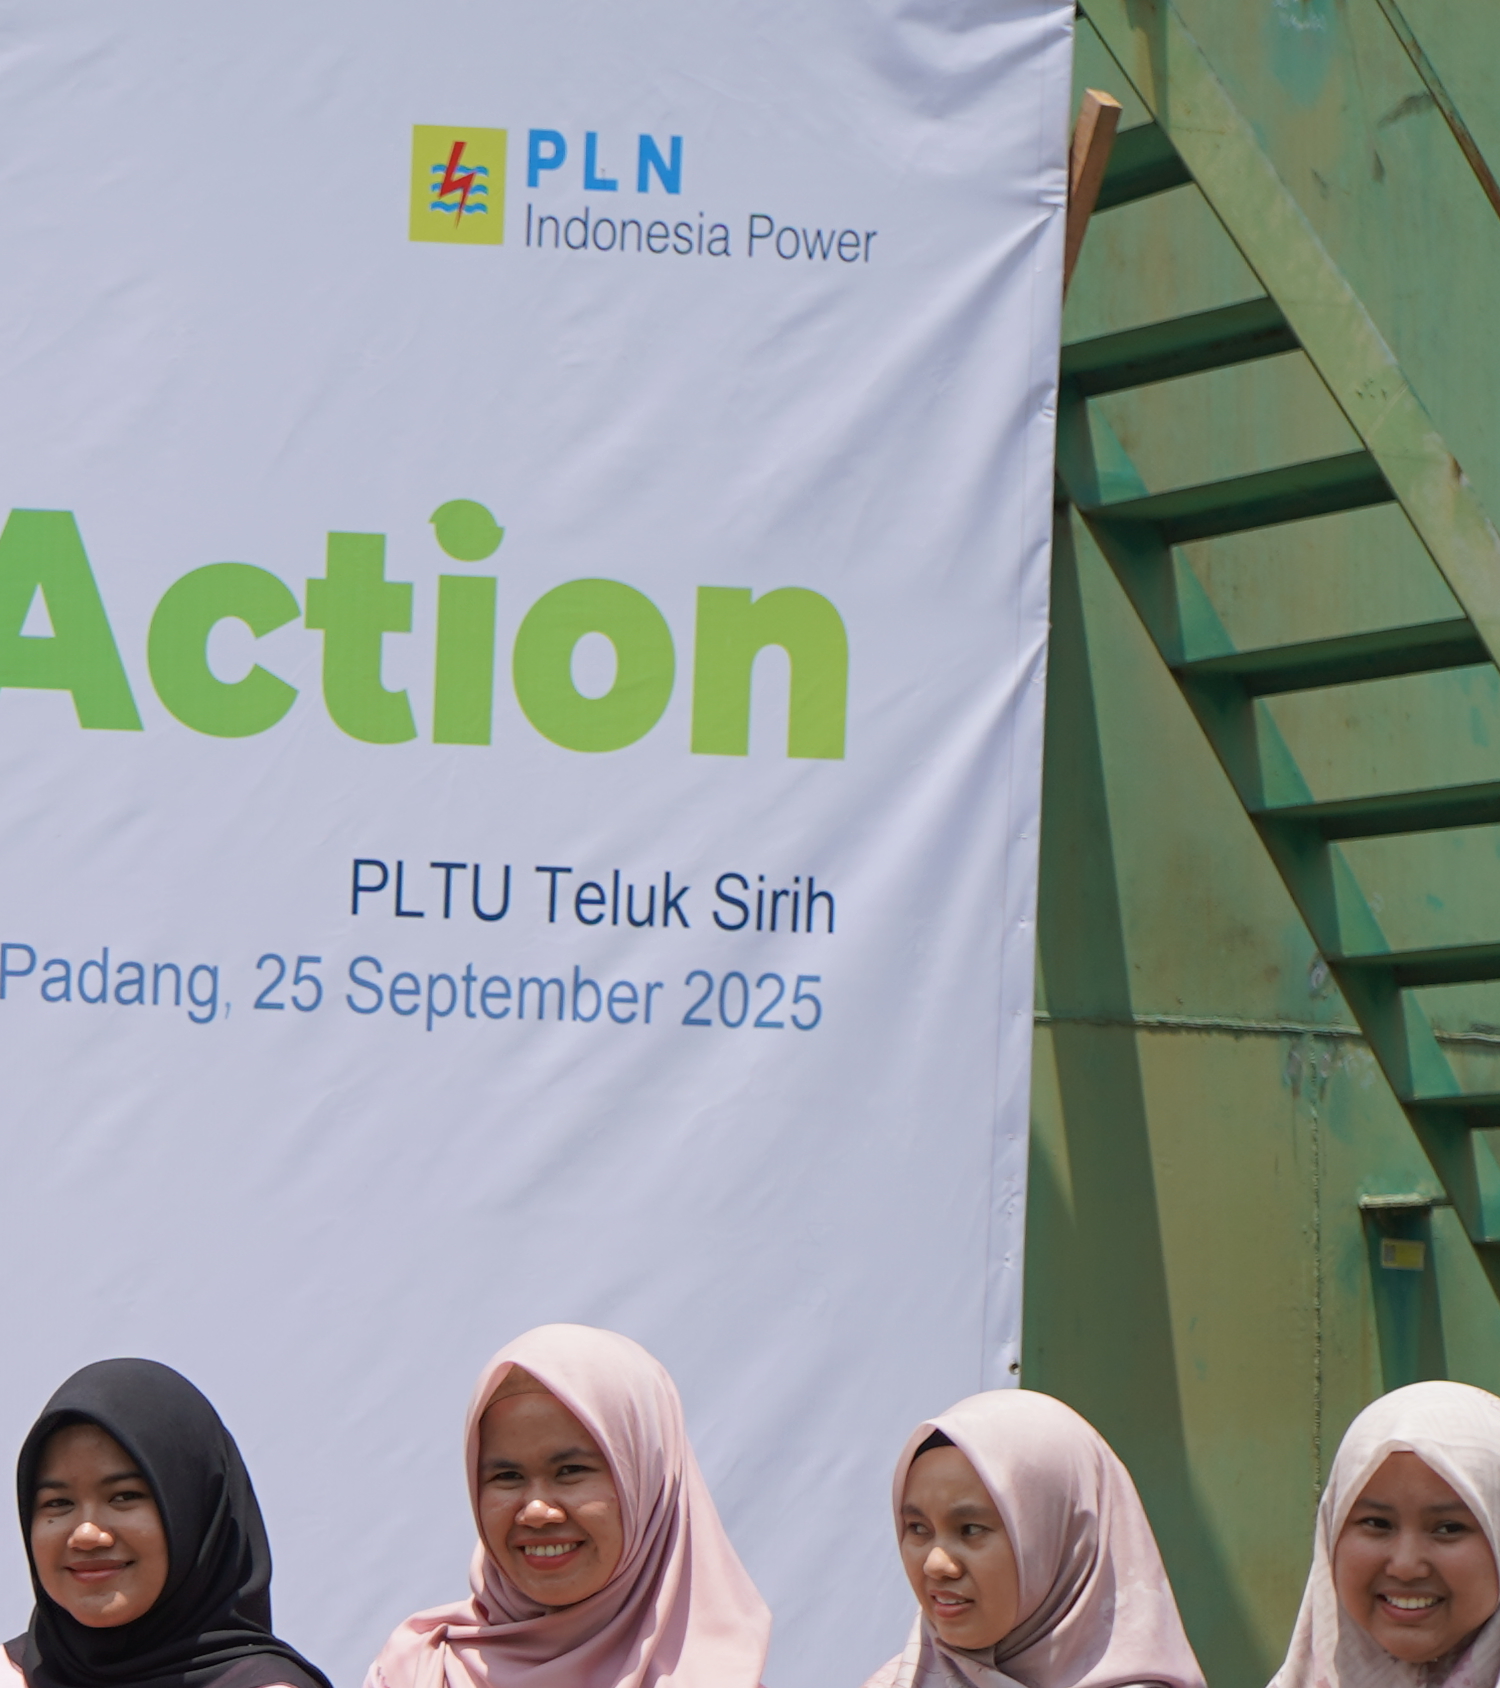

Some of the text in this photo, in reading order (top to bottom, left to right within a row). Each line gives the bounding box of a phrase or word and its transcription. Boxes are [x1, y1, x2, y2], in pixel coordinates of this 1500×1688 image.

[527, 128, 684, 195] PLN
[525, 203, 878, 263] Indonesia Power
[351, 858, 835, 934] PLTU Teluk Sirih
[253, 952, 324, 1013] 25
[346, 954, 665, 1032] September
[681, 969, 823, 1032] 2025
